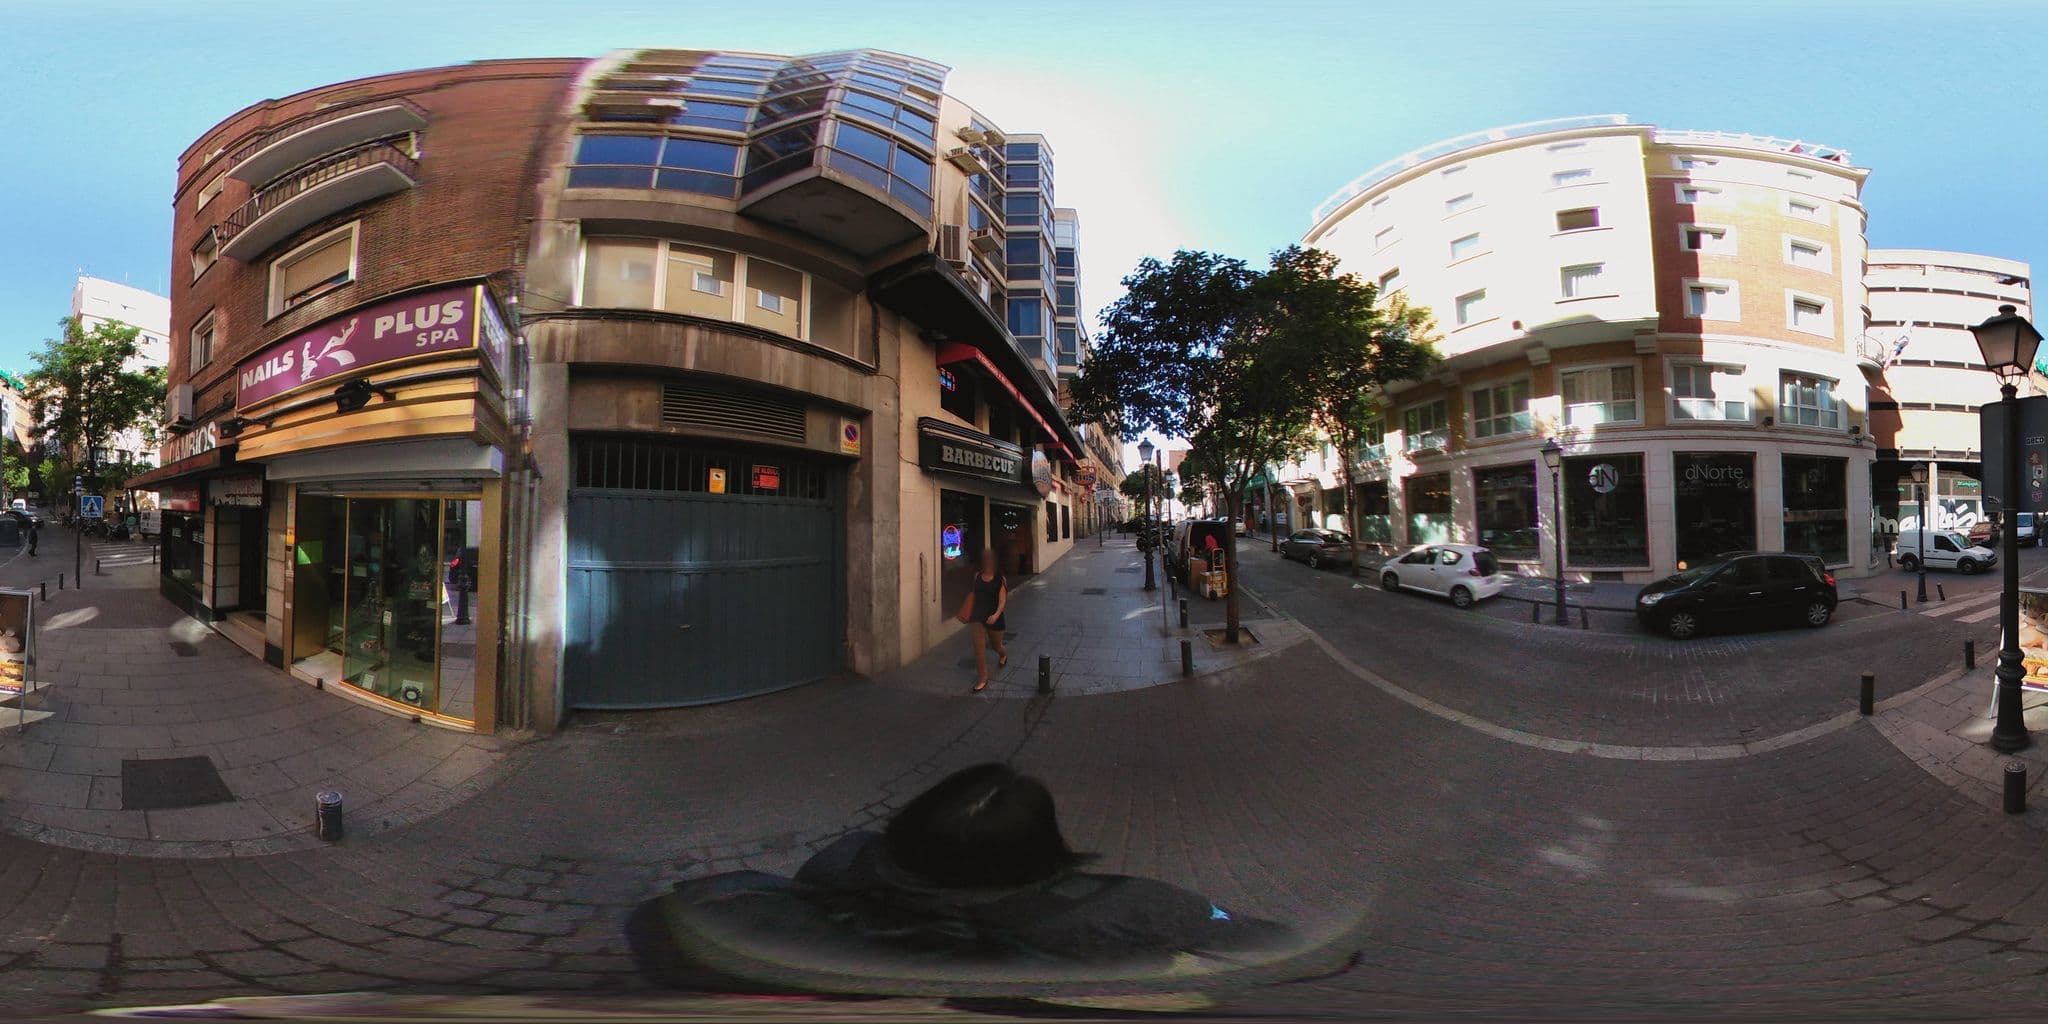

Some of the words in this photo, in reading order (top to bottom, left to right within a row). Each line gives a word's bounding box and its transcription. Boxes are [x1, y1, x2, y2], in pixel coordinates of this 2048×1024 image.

[242, 350, 294, 391] NAILS
[374, 300, 464, 340] PLUS
[416, 327, 460, 347] SPA
[942, 445, 1016, 475] BARBECUE
[1685, 464, 1744, 480] dNorte
